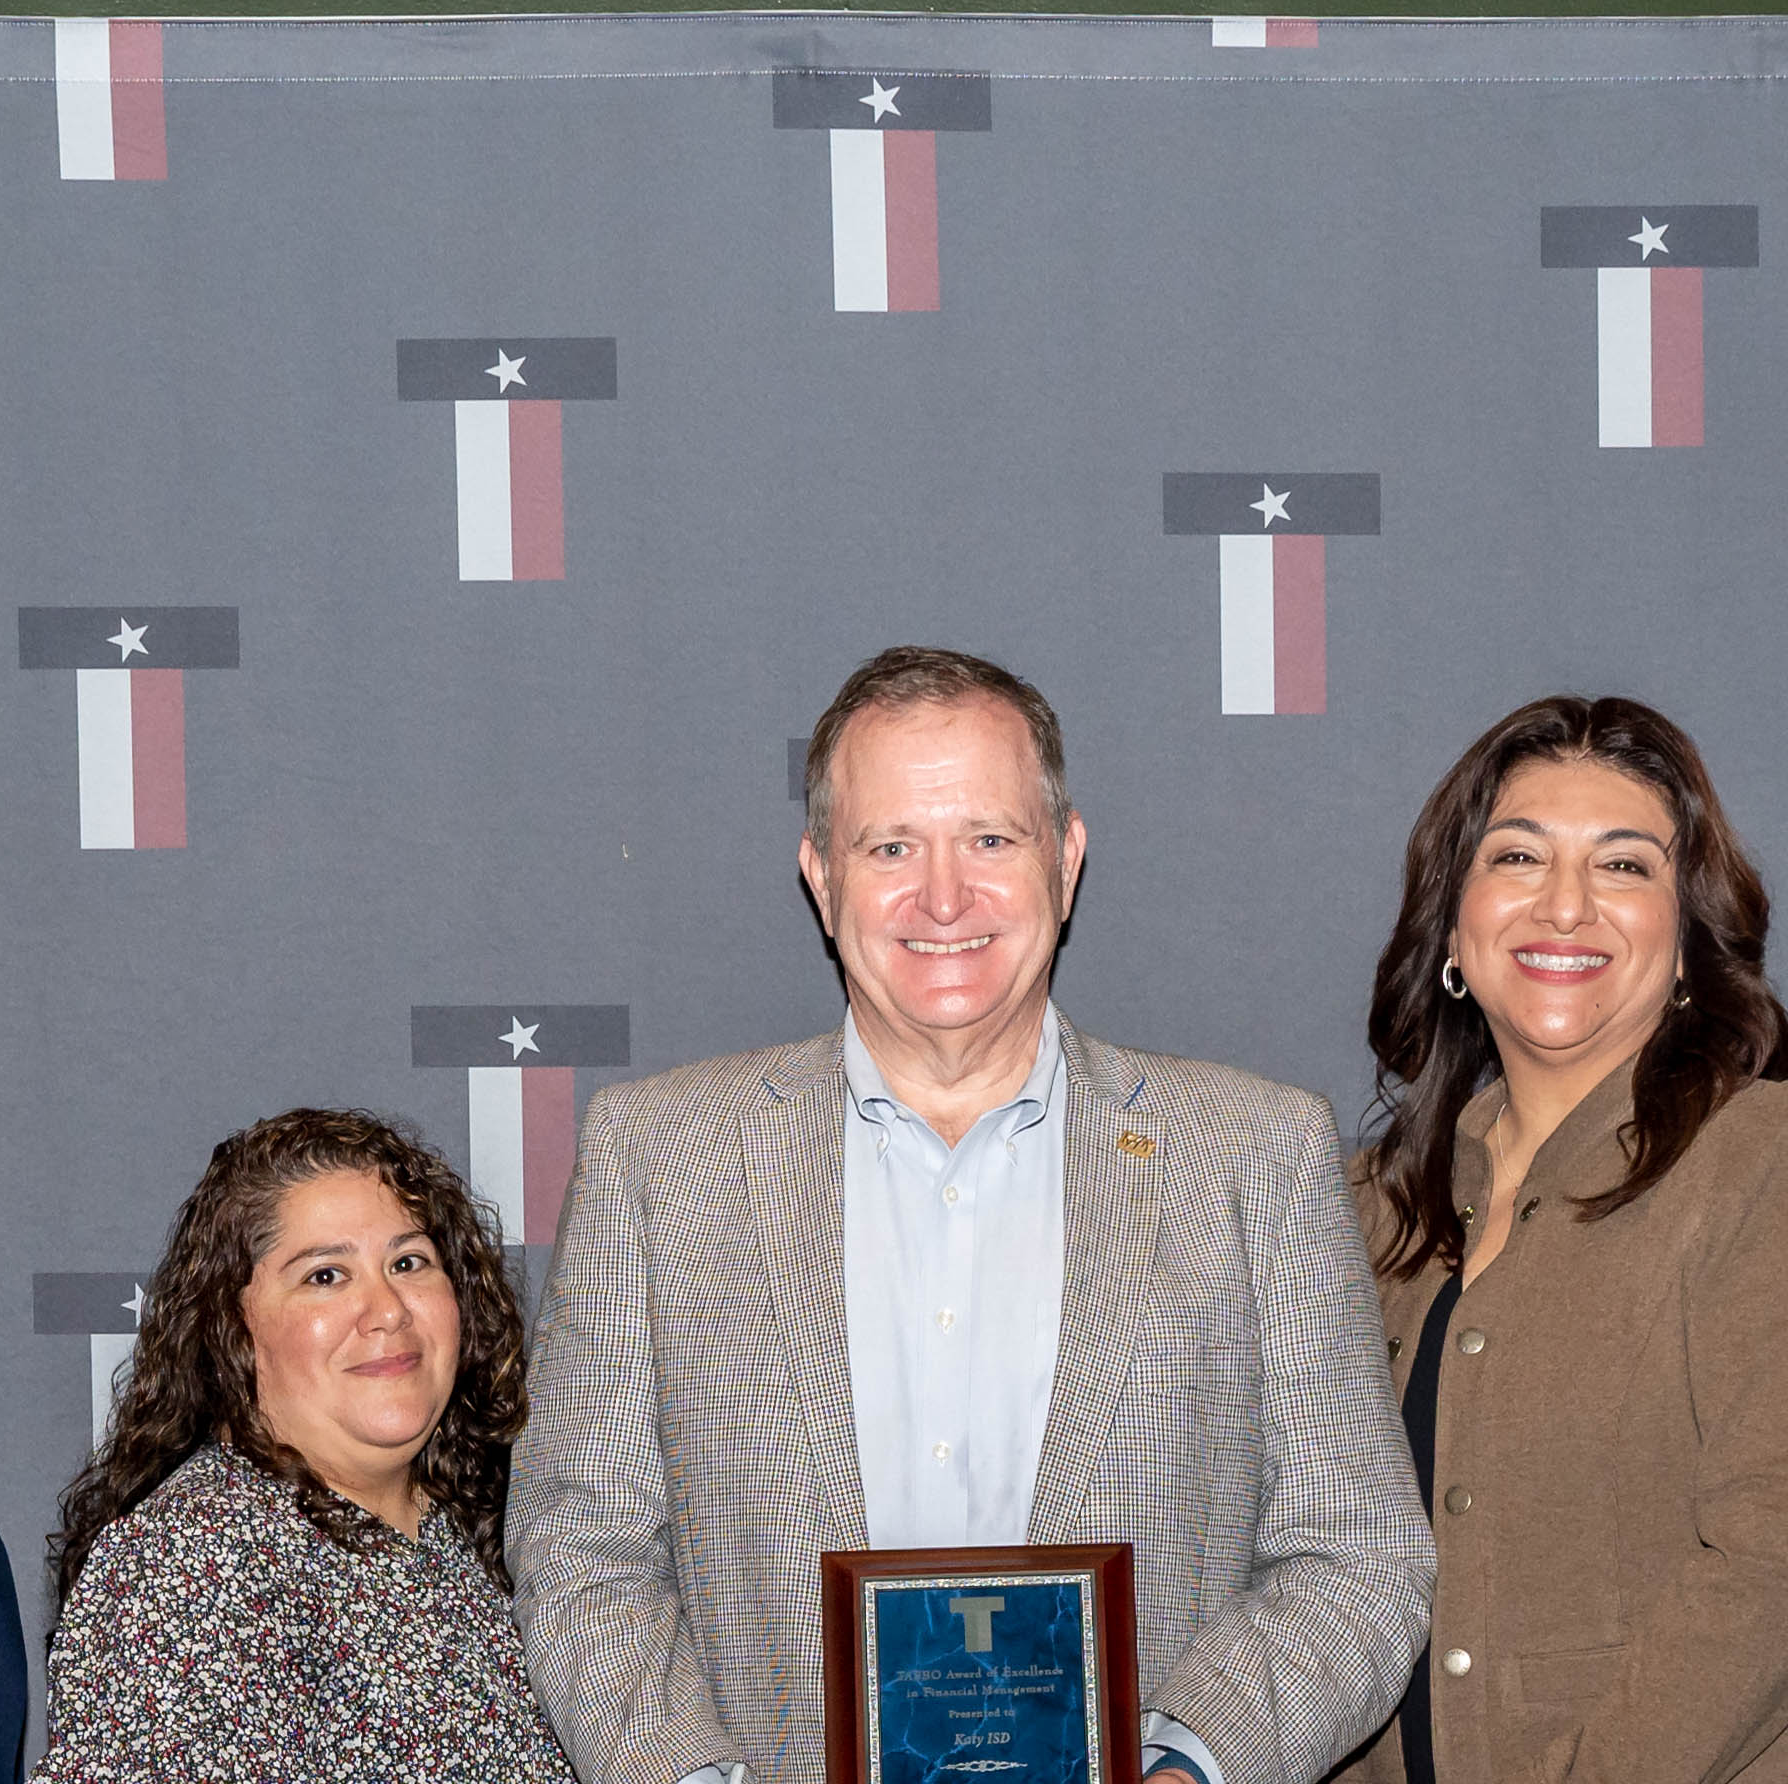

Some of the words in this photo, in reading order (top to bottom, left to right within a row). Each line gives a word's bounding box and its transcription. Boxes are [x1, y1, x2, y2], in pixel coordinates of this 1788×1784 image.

[946, 1666, 982, 1680] Award
[923, 1683, 978, 1698] Financial
[981, 1683, 1056, 1697] Management
[948, 1707, 1001, 1719] Presented
[1003, 1708, 1016, 1718] to
[954, 1733, 984, 1748] Katy
[987, 1731, 1011, 1745] ISD
